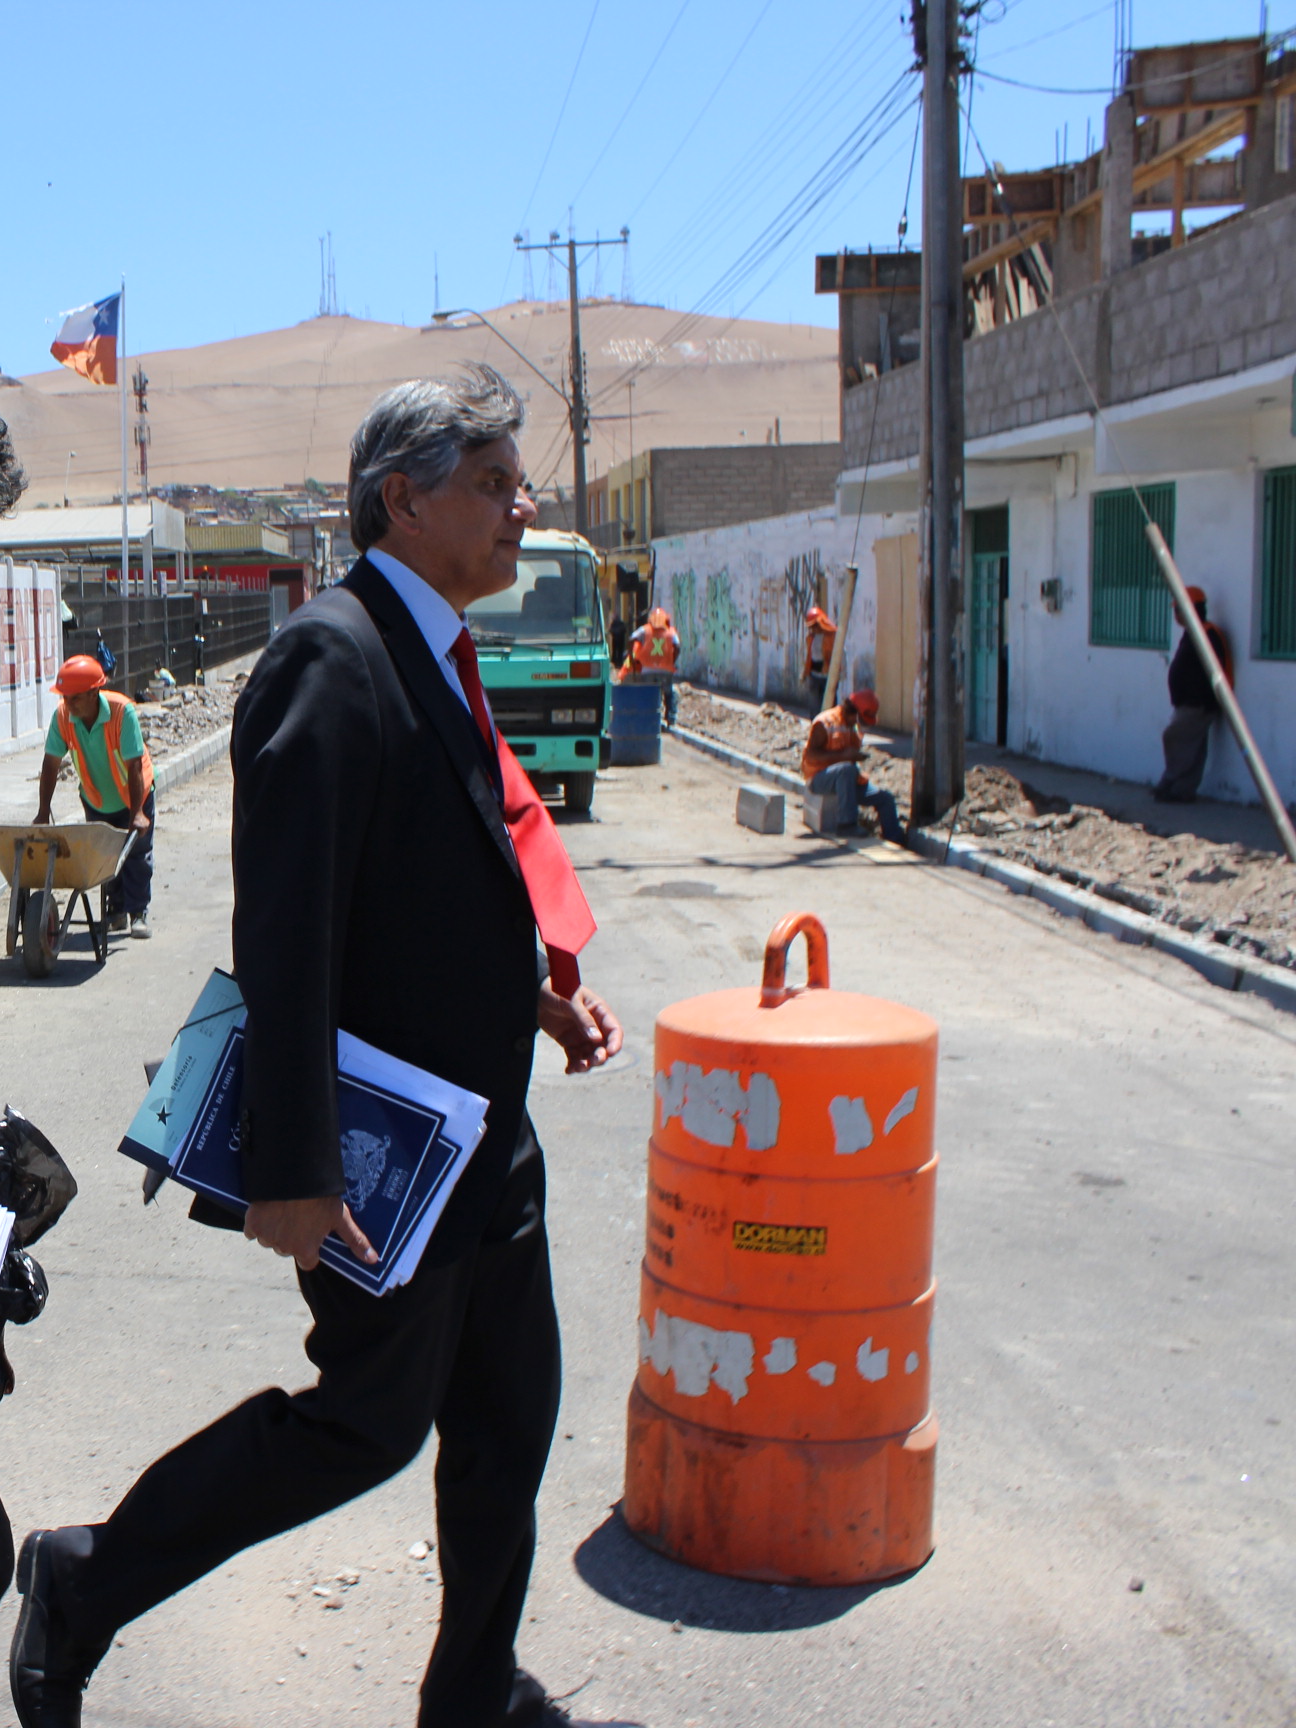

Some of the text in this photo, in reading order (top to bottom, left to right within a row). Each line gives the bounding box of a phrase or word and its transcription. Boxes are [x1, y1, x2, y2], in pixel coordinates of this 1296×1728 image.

[216, 1093, 224, 1105] DE
[222, 1065, 237, 1091] CHILE
[735, 1222, 825, 1246] DORMAN
